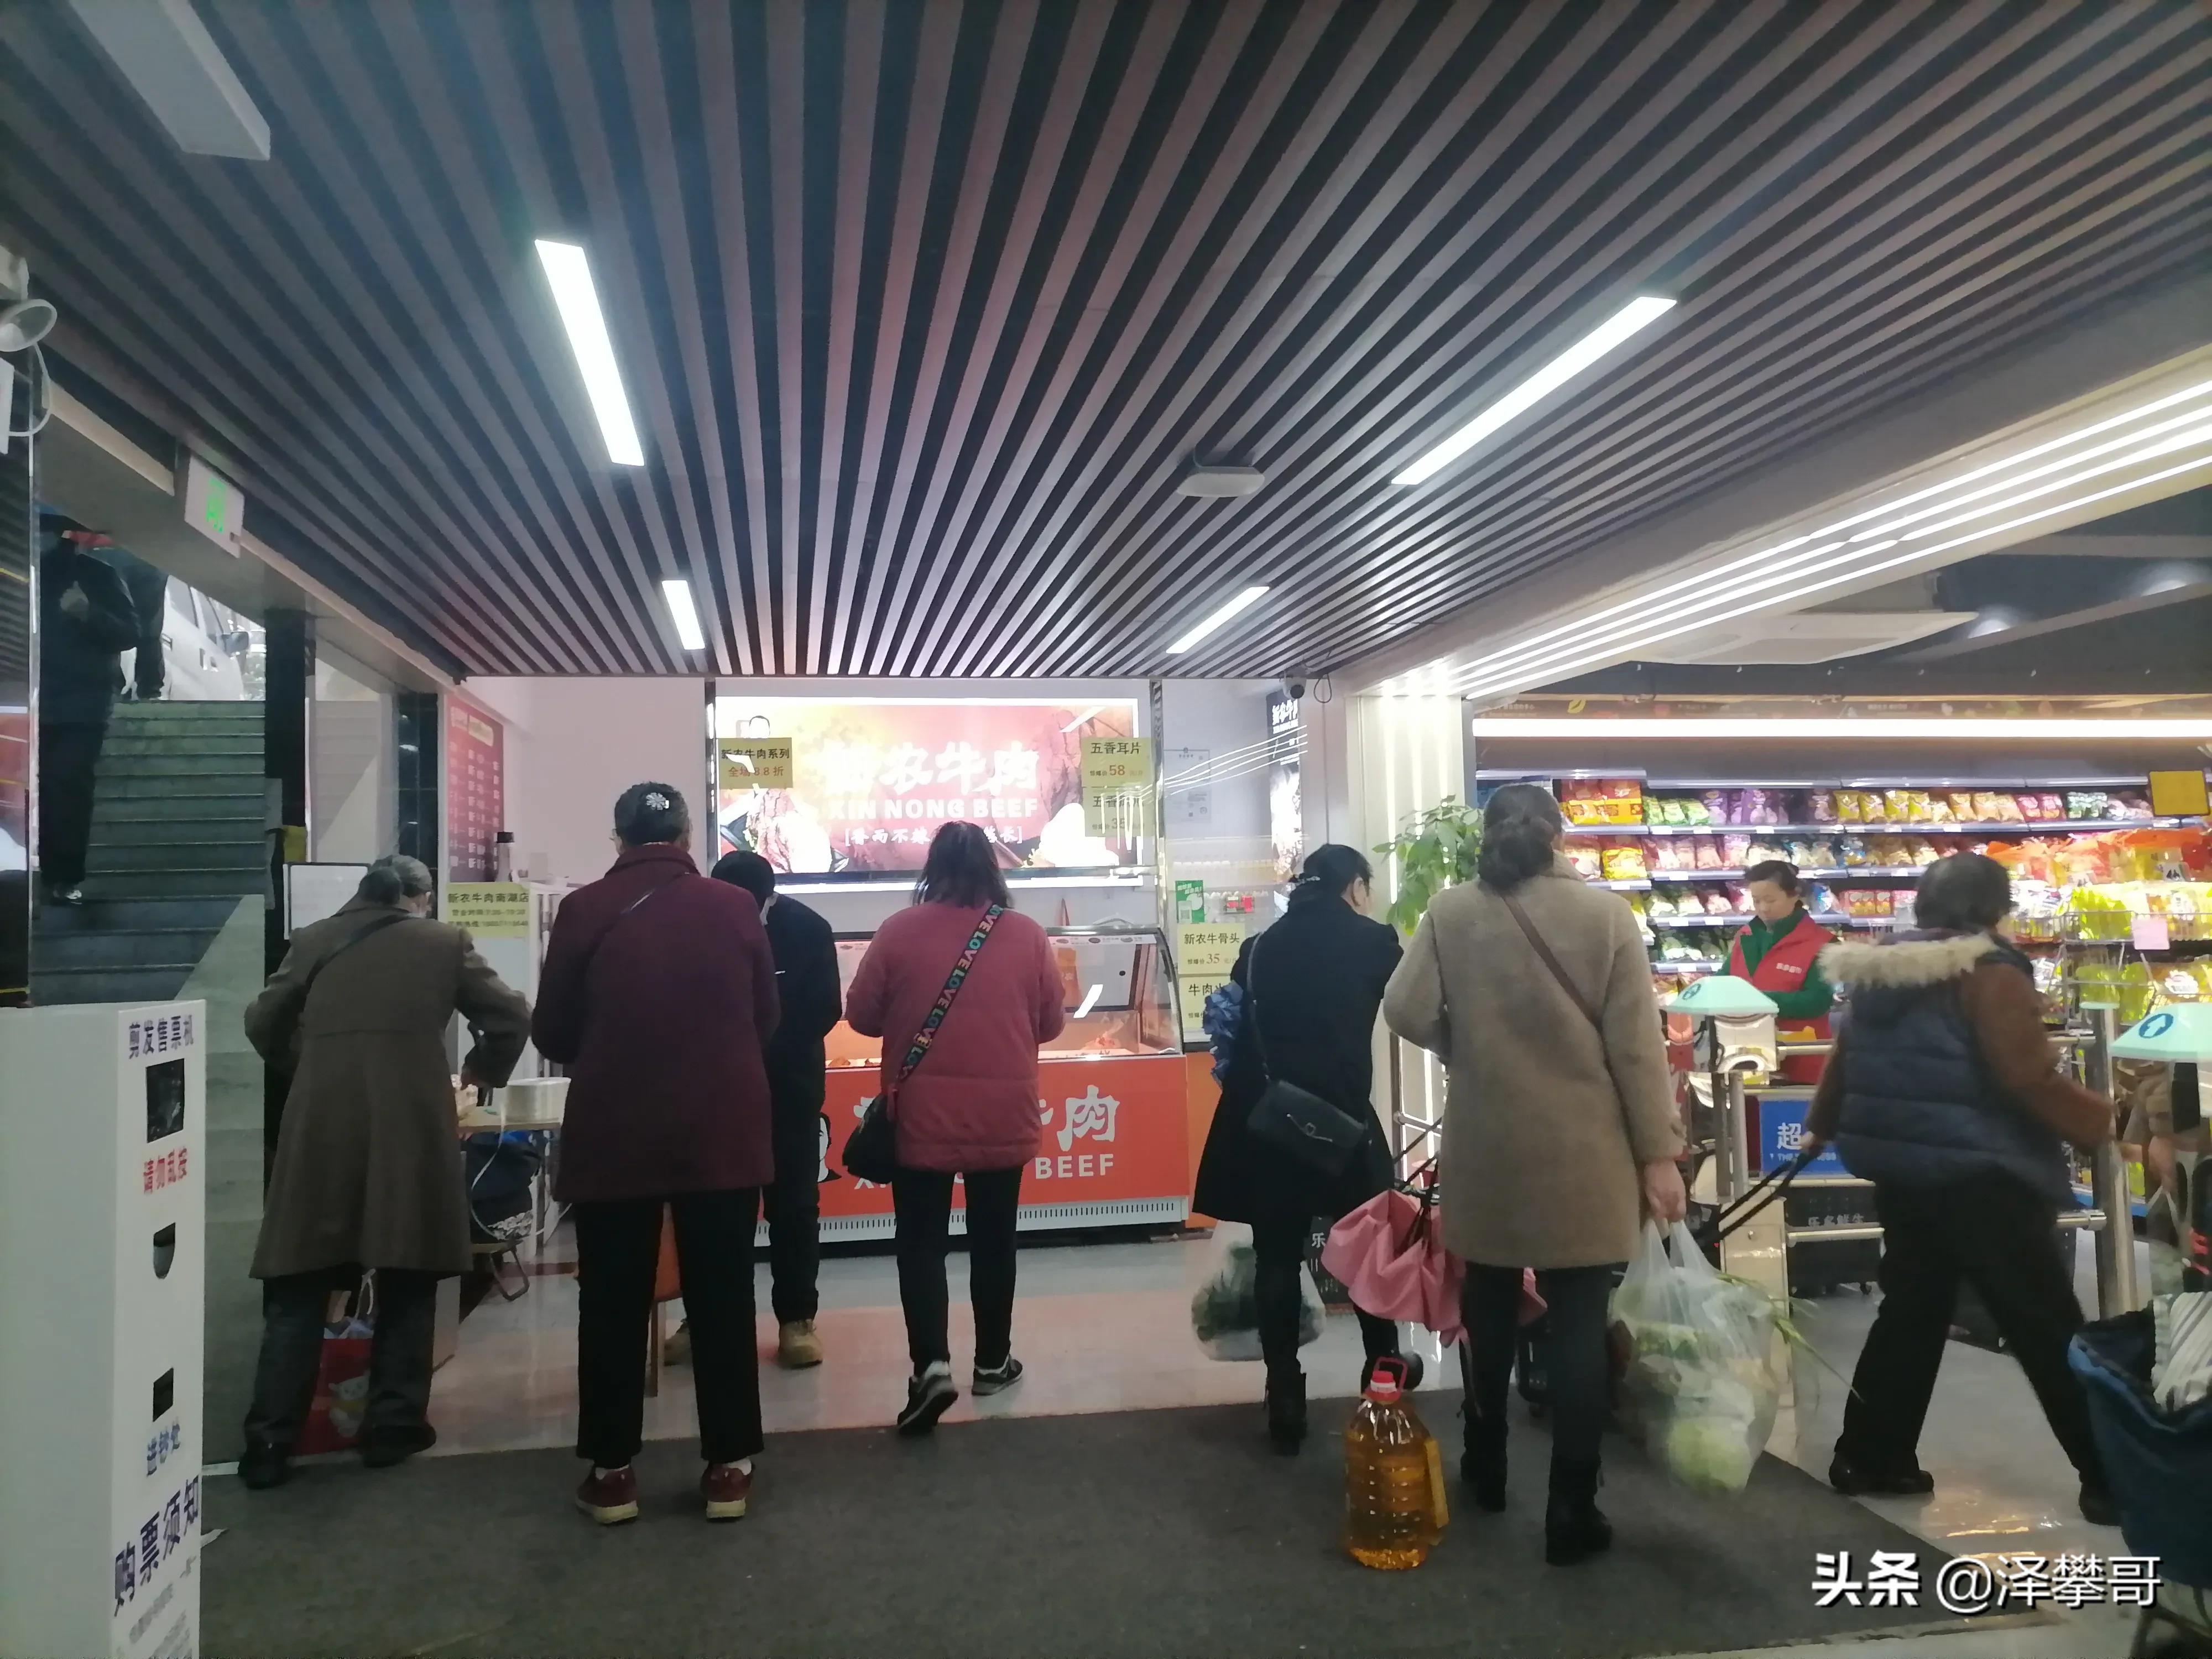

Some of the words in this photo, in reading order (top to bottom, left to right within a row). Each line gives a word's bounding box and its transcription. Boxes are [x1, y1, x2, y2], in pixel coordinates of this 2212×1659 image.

[1091, 742, 1141, 755] 五香耳片
[1109, 764, 1125, 775] 58
[829, 800, 877, 819] XIN
[884, 799, 965, 818] NONG
[973, 799, 1037, 818] BEEF
[958, 931, 986, 969] LOVE
[1184, 932, 1239, 945] 新农牛骨头
[1207, 953, 1220, 964] 35
[938, 969, 965, 1008] LOVE
[1039, 1084, 1120, 1151] 肉
[1777, 1123, 1802, 1150] 超
[1035, 1154, 1114, 1179] BEEF
[113, 1475, 199, 1618] 购票须知
